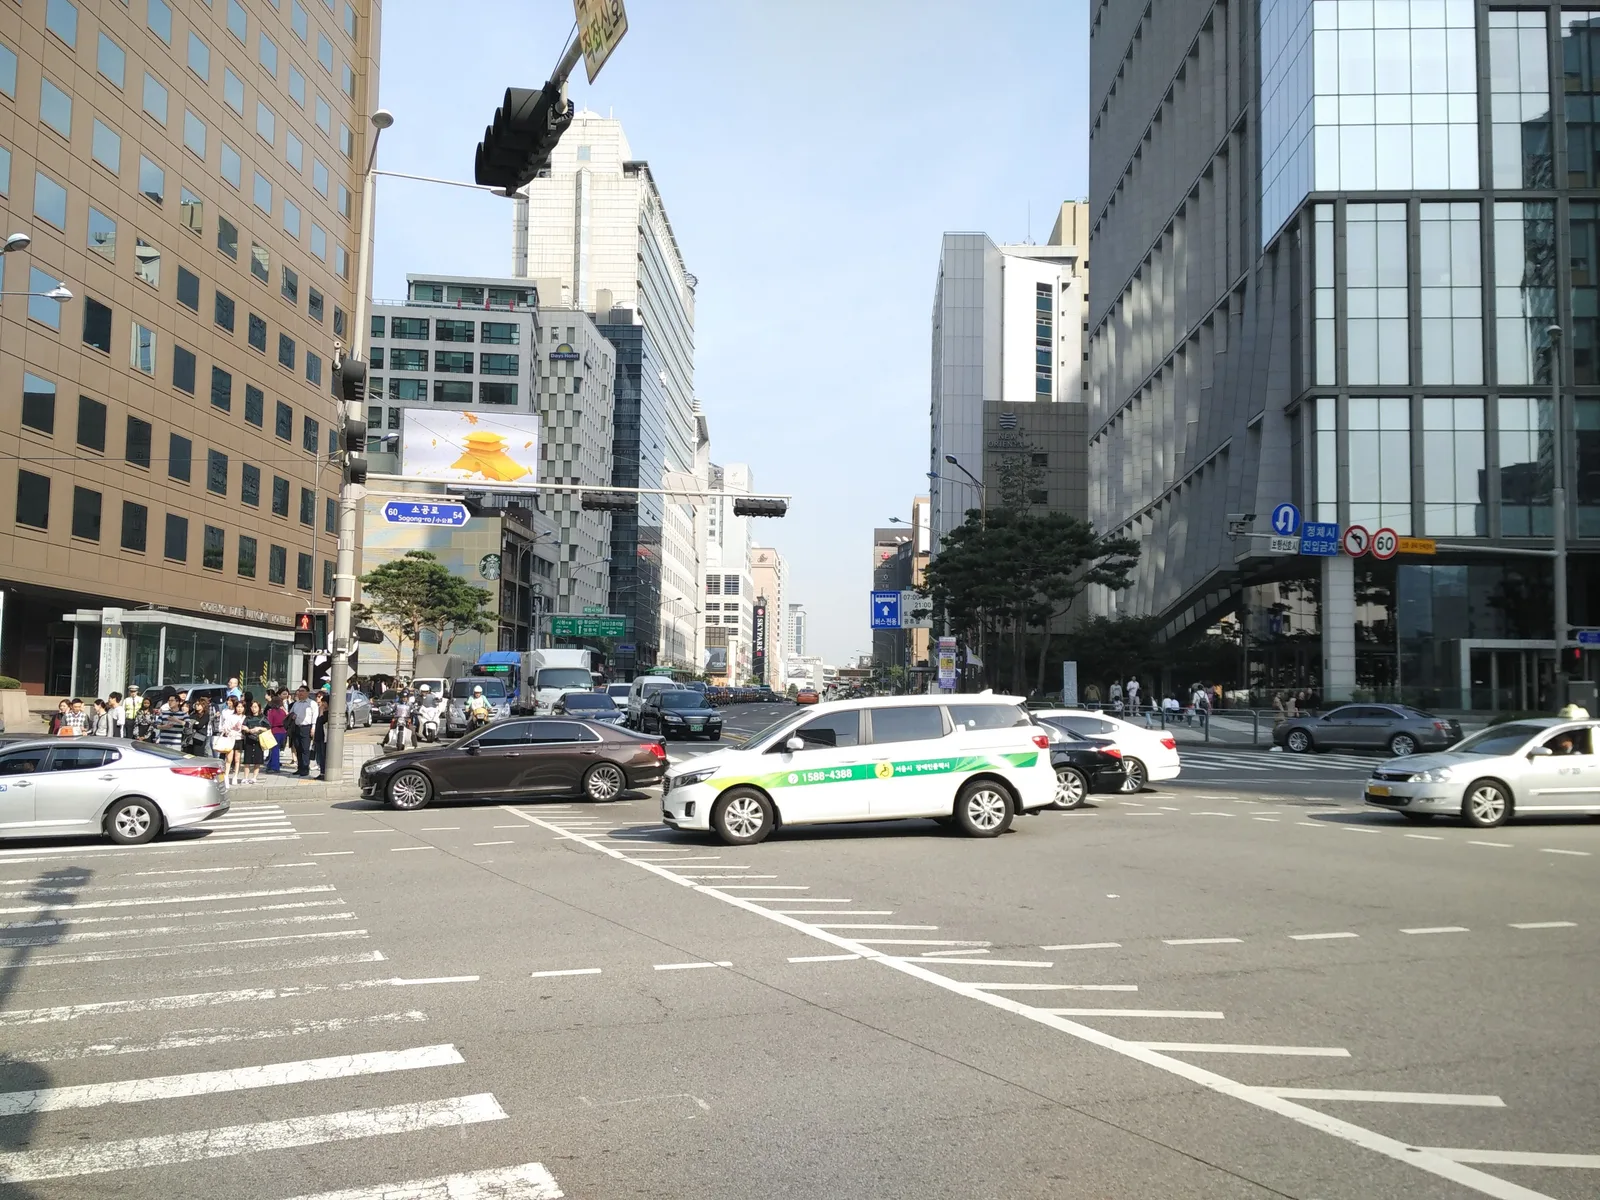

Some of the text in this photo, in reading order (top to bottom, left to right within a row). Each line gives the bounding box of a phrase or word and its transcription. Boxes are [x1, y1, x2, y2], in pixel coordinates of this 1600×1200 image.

[388, 508, 398, 516] 60
[411, 505, 439, 515] 소공로
[453, 511, 462, 519] 54
[1307, 525, 1335, 538] 정체시
[1271, 539, 1298, 551] 보행신호시
[1303, 540, 1337, 553] 진입금지
[1377, 536, 1393, 551] 60
[875, 617, 897, 626] 버스전용
[106, 627, 112, 635] 4
[895, 764, 913, 773] 서울시
[802, 769, 852, 782] 1588-4388
